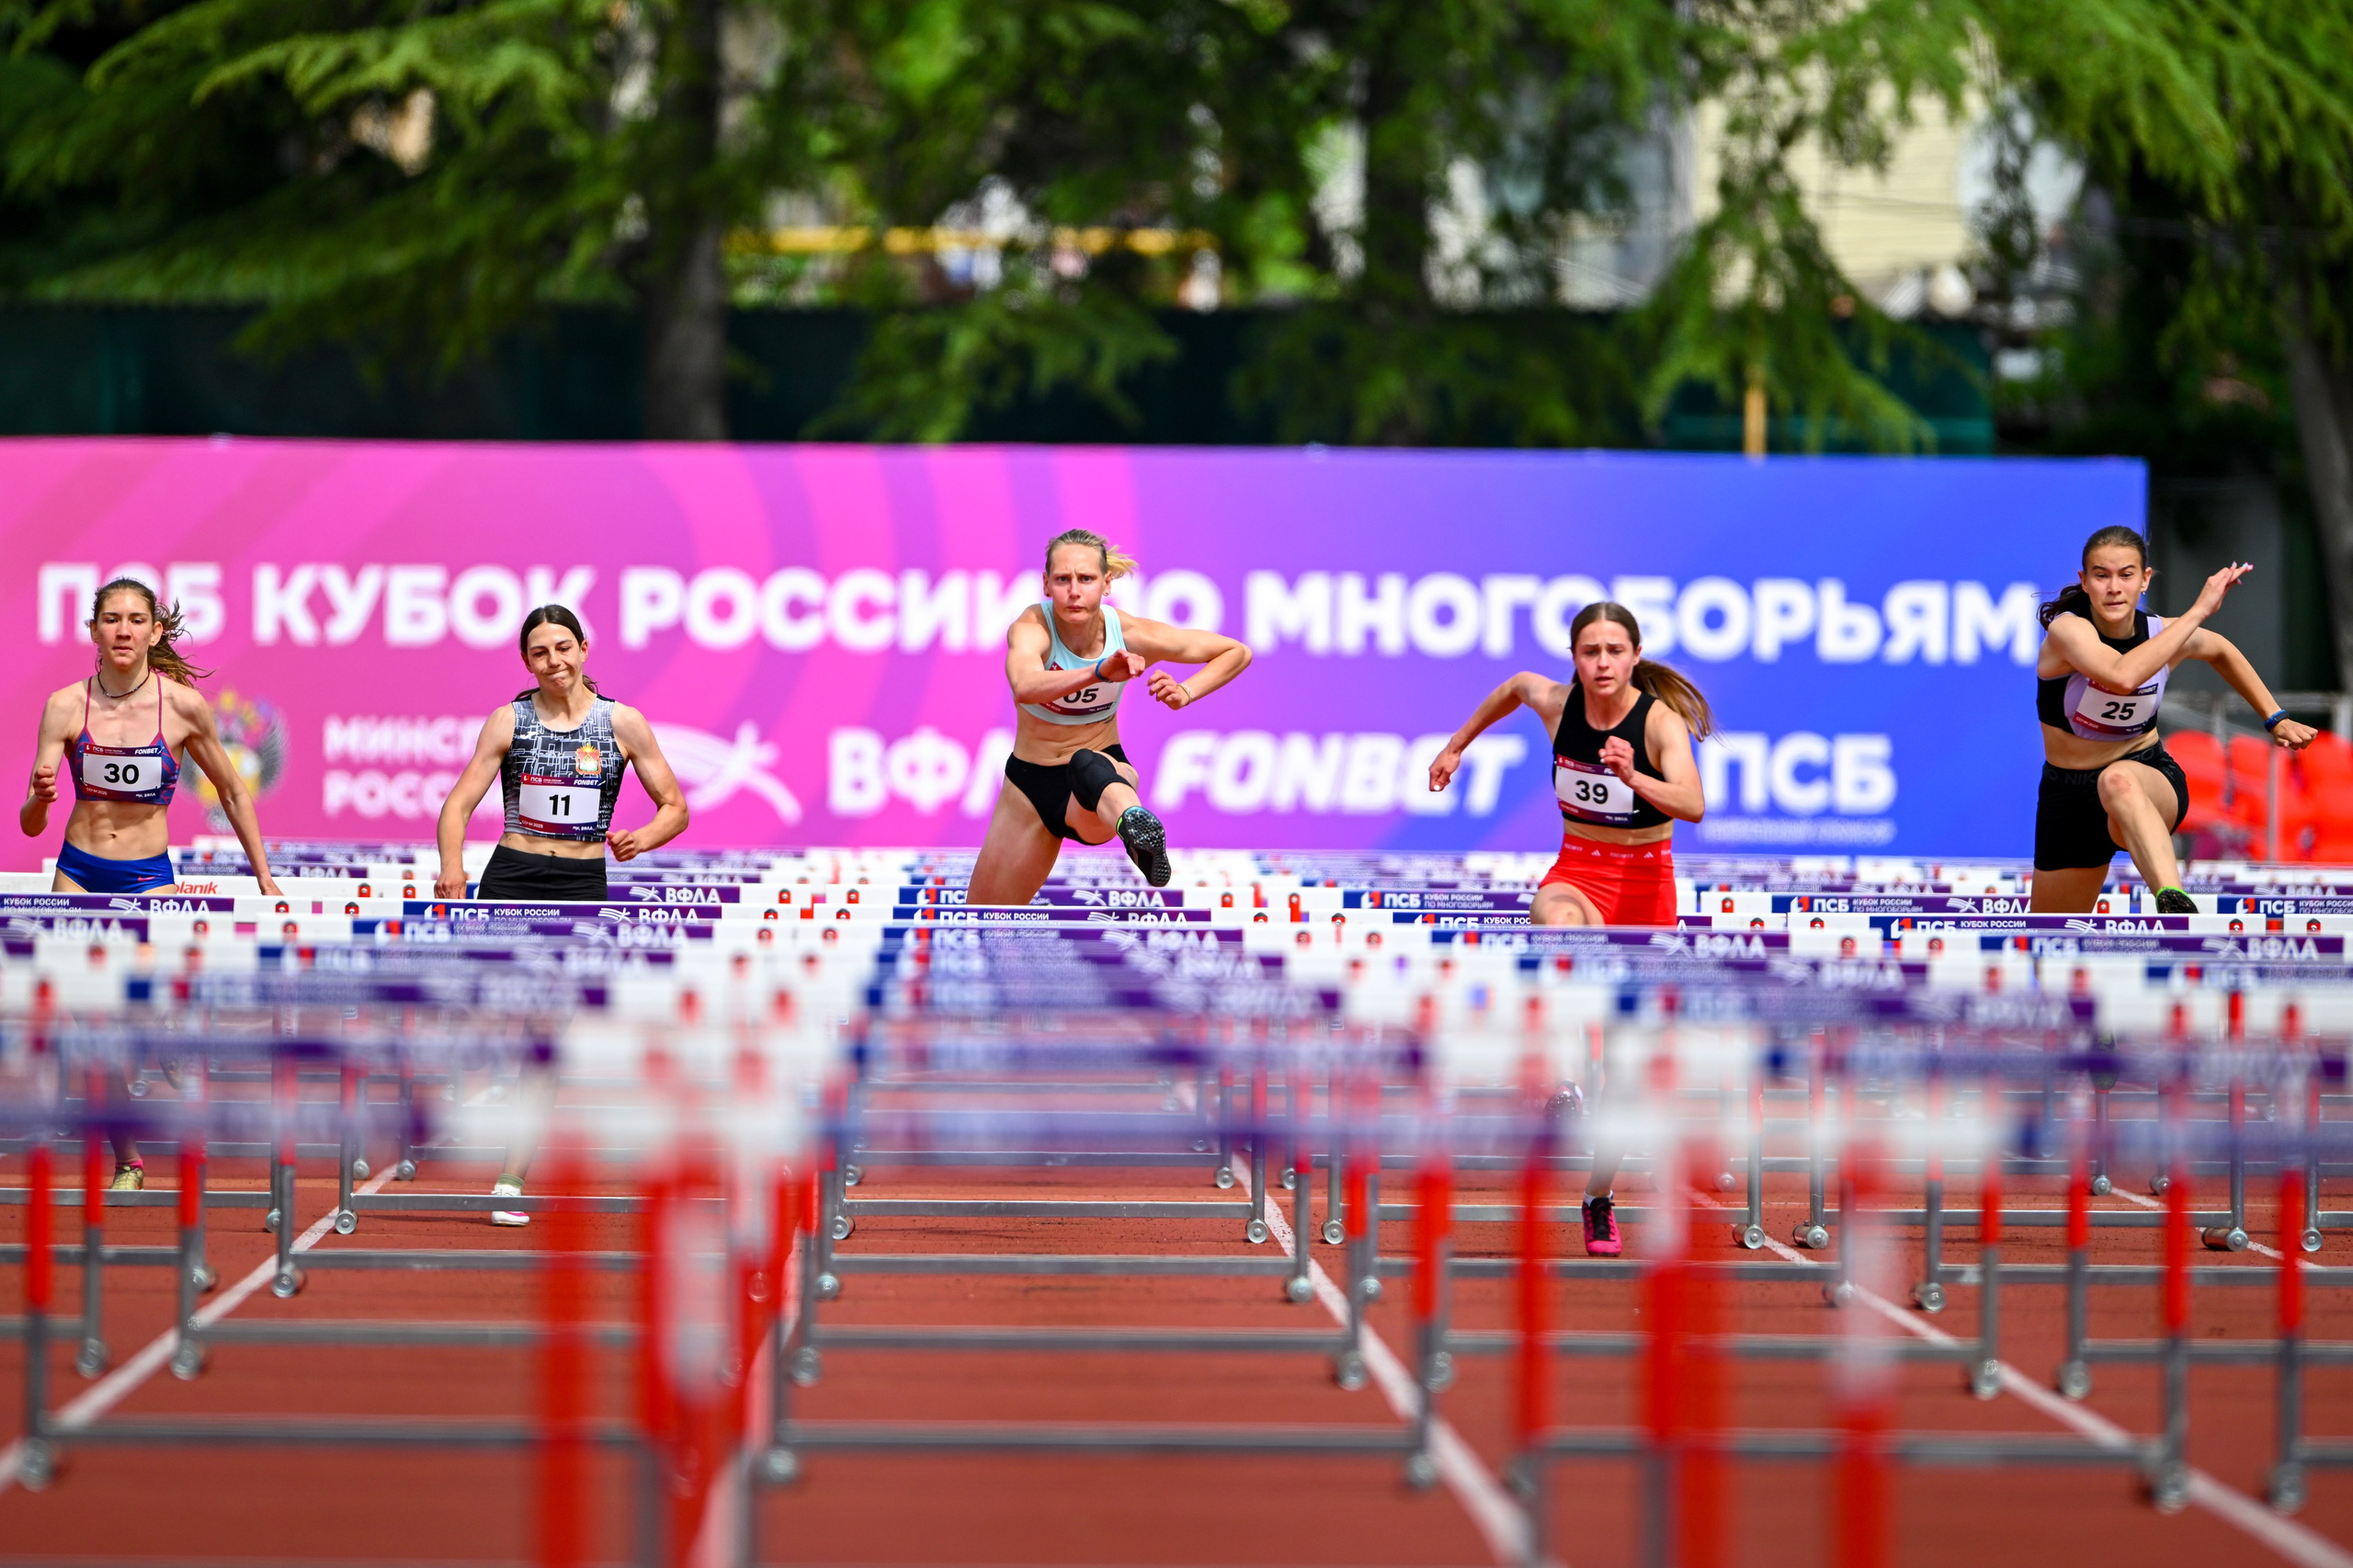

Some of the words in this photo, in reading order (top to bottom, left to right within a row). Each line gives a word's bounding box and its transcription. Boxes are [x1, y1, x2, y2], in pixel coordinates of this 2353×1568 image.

[38, 562, 226, 647] ПБ
[1243, 570, 2040, 668] МНОГОБОРЬЯМ
[2100, 701, 2137, 721] 25
[134, 747, 159, 756] FONBET
[104, 763, 140, 784] 30
[829, 724, 1016, 818] ВФЛ
[1151, 730, 1528, 817] FONBET
[1699, 732, 1897, 816] ПСБ
[2064, 772, 2097, 786] NIK
[1574, 779, 1608, 804] 39
[549, 794, 570, 816] 11
[175, 881, 218, 894] lanik
[665, 887, 722, 903] ВФЛА
[4, 897, 32, 906] КУБОК
[33, 898, 70, 907] РОССИИ
[939, 890, 968, 904] ПС
[1108, 890, 1165, 907] ВФЛА
[1384, 893, 1421, 908] ПСБ
[1813, 898, 1849, 912] ПСБ
[17, 906, 82, 915] МНОГОБОРЬЯМ
[150, 899, 210, 916] ВФЛА
[450, 908, 490, 922] ПСБ
[494, 908, 522, 916] КУБОК
[524, 908, 560, 916] РОССИИ
[2259, 900, 2296, 914] ПСБ
[639, 908, 699, 925] ВФЛА
[939, 911, 979, 926] ПСБ
[983, 912, 1012, 920] КУБОК
[1013, 913, 1050, 921] РОССИИ
[1128, 912, 1188, 926] ВФЛА
[1439, 916, 1479, 930] ПСБ
[1483, 916, 1512, 925] КУБОК
[53, 916, 124, 942] ВФЛА
[404, 922, 451, 943] ПСБ
[1916, 920, 1957, 933] ПСБ
[2106, 920, 2165, 935] ВФЛА
[617, 924, 689, 949] ВФЛА
[933, 928, 982, 950] ПСБ
[1481, 932, 1529, 953] ПСБ
[1694, 934, 1767, 958] ВФЛА
[2032, 937, 2081, 958] ПСБ
[2247, 937, 2319, 960] ВФЛА
